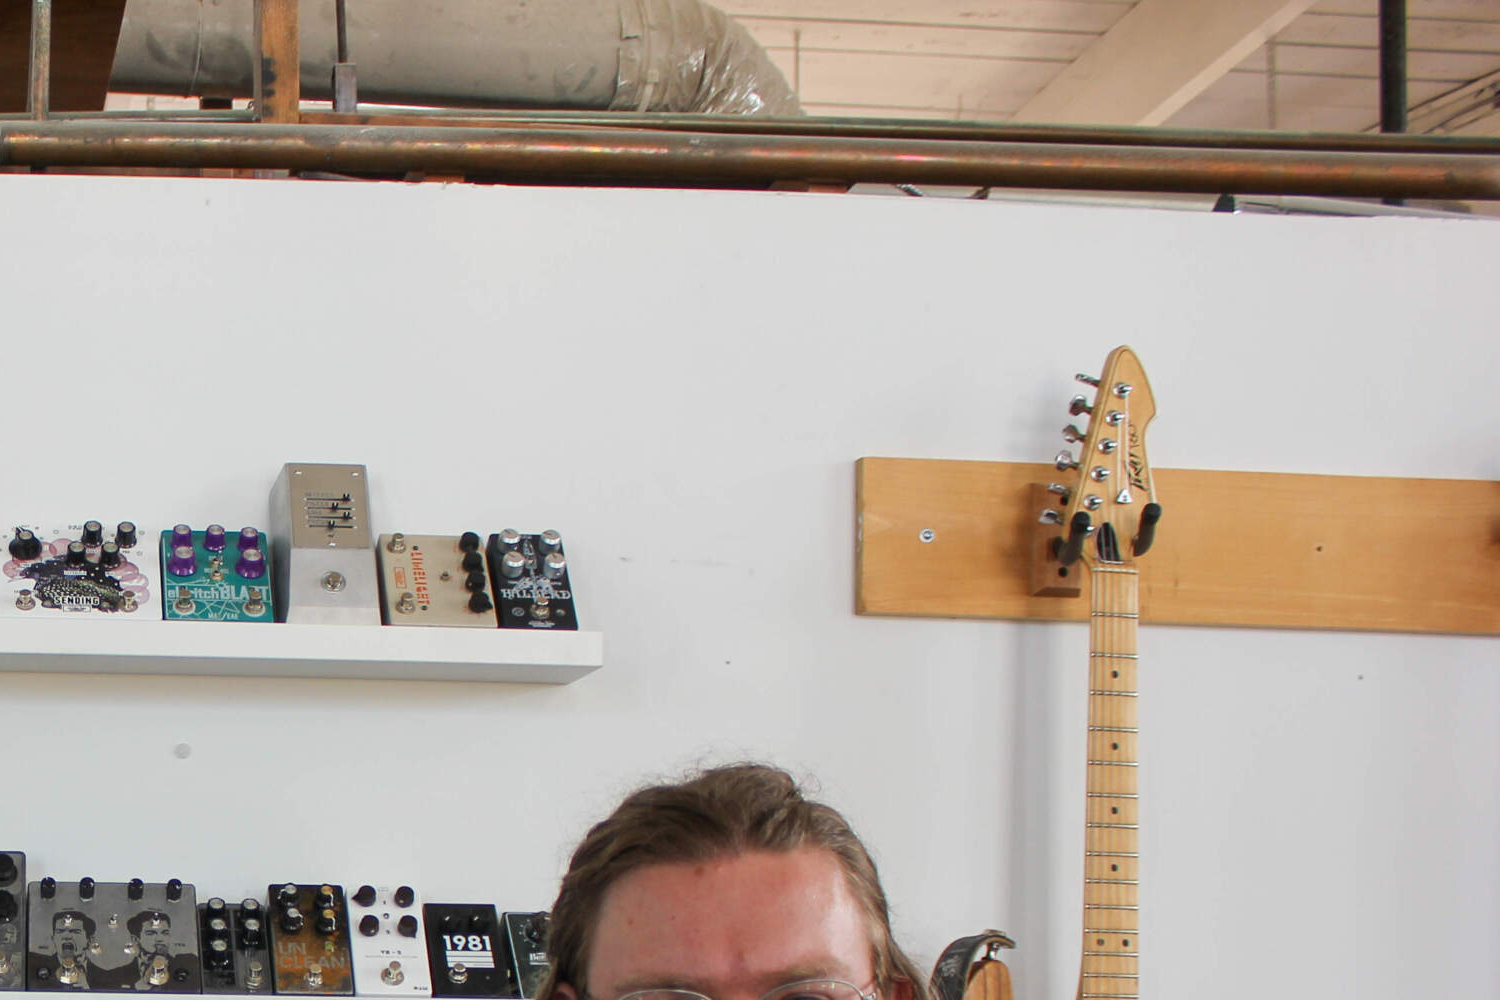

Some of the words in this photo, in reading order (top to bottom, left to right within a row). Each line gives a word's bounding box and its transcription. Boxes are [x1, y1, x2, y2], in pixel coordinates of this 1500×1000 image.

[54, 596, 100, 605] SENDING
[277, 942, 306, 954] UN
[442, 935, 493, 951] 1981
[279, 955, 345, 969] CLEAN
